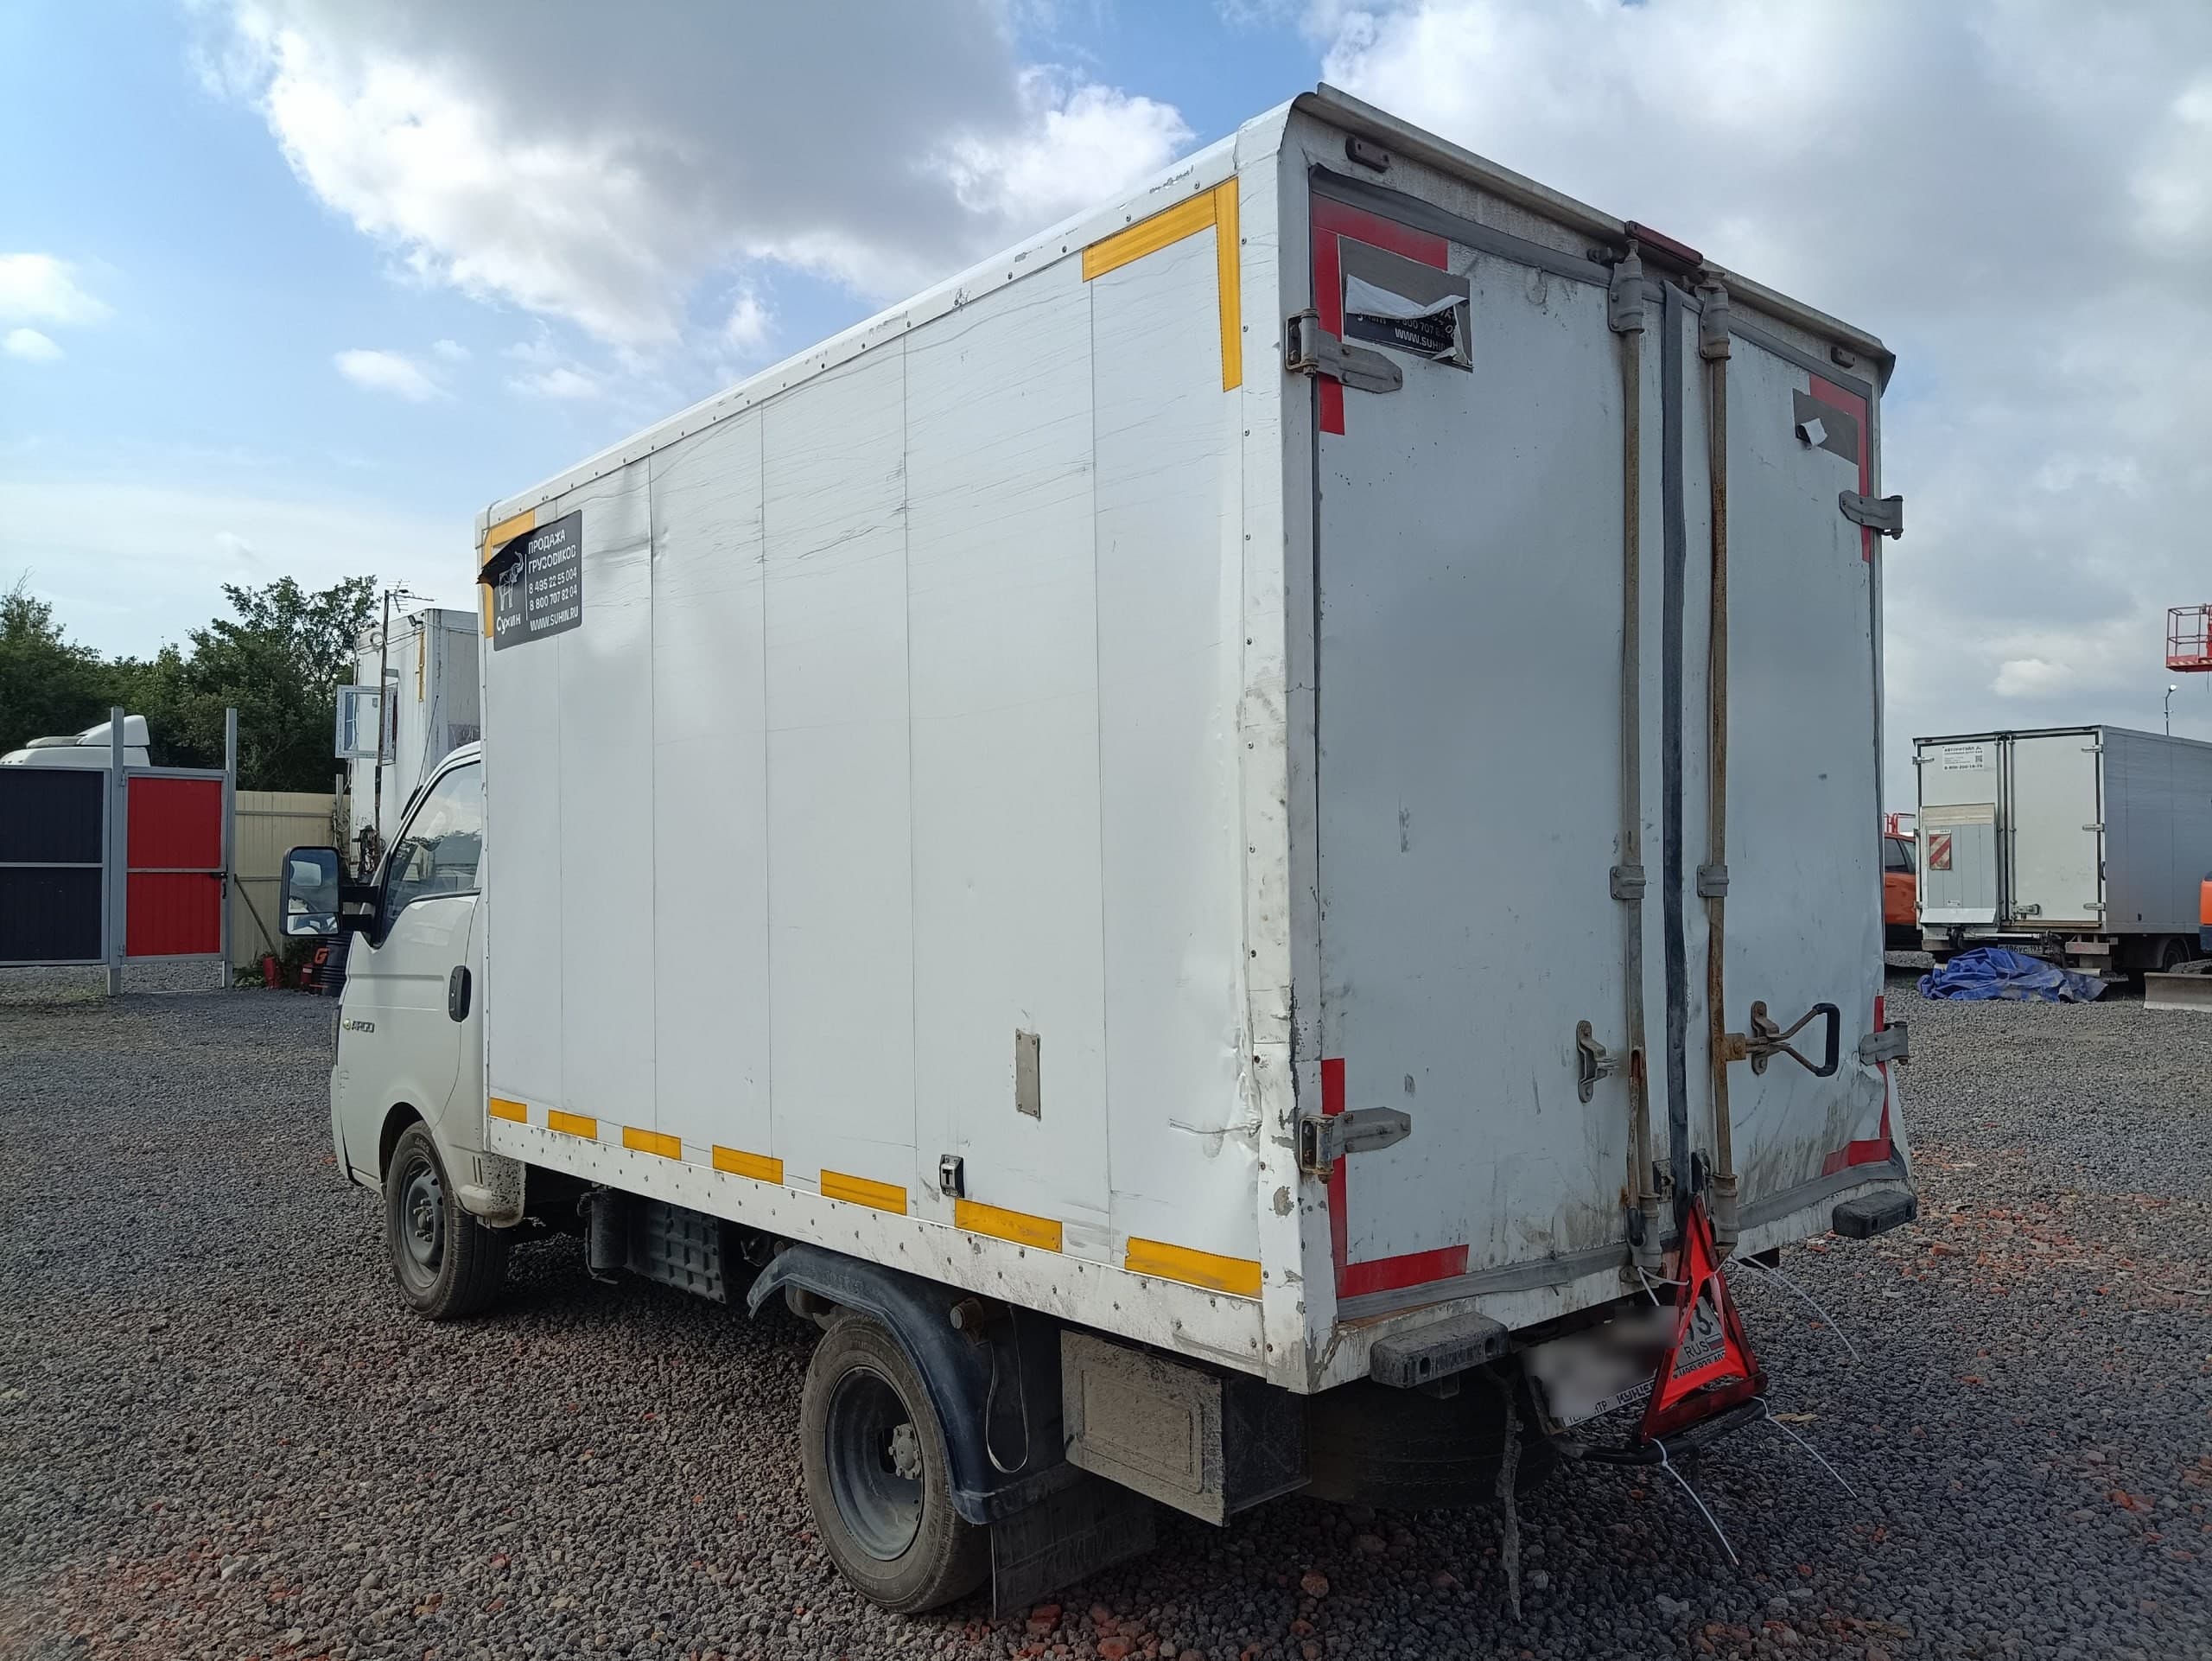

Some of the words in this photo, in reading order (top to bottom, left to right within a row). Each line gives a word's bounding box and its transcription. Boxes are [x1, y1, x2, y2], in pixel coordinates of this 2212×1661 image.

[528, 529, 566, 554] ПРОДАЖА
[528, 544, 576, 575] ГРУЗОВИКОВ
[529, 582, 534, 595] 8
[534, 577, 548, 592] 495
[549, 575, 556, 588] 22
[557, 572, 565, 584] 55
[565, 567, 577, 582] 004
[530, 600, 534, 611] 8
[535, 595, 549, 609] 800
[550, 591, 561, 606] 707
[562, 588, 569, 601] 82
[569, 584, 578, 597] 04
[530, 606, 579, 632] WWW.SUHIN.RU
[1684, 1341, 1709, 1359] RUS
